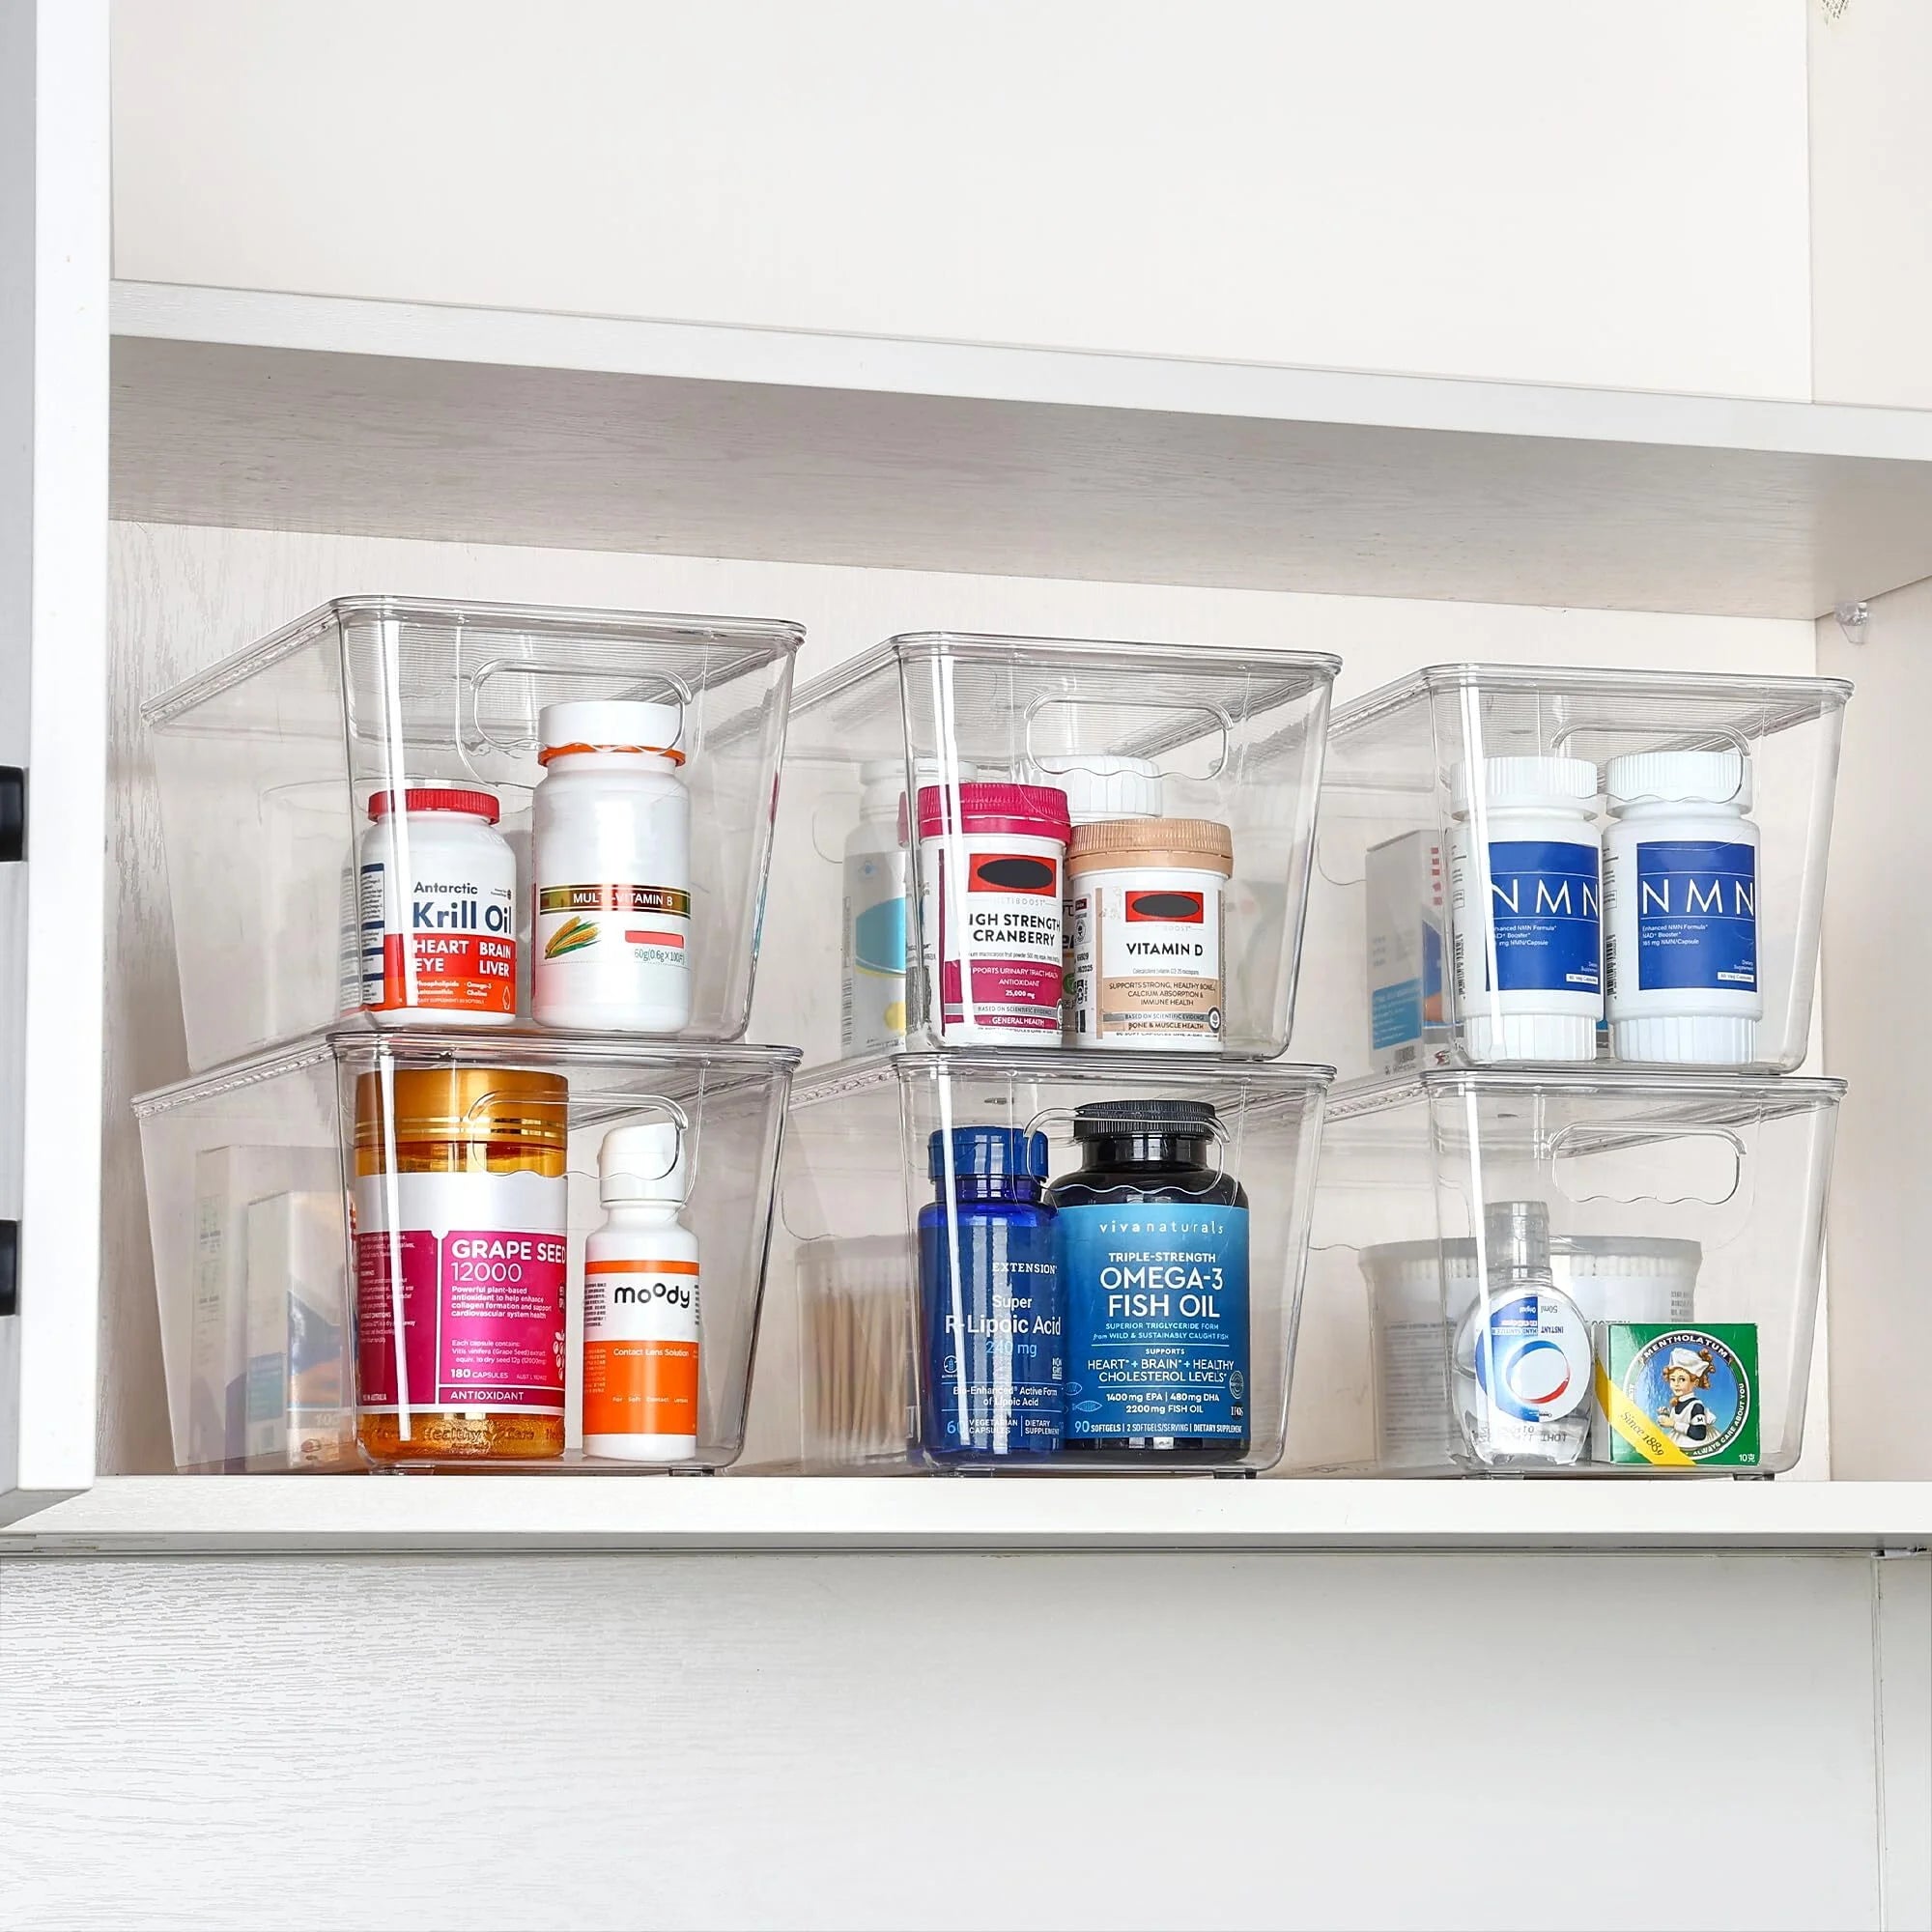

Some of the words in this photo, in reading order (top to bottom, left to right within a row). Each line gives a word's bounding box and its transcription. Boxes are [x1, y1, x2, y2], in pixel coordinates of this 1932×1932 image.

[413, 881, 478, 895] Antarctic
[667, 895, 673, 907] B
[412, 900, 477, 929] Krill
[485, 905, 512, 934] Oil
[969, 913, 998, 926] IGH
[1004, 914, 1061, 932] STRENGTH
[973, 929, 1055, 947] CRANBERRY
[413, 939, 469, 954] HEART
[479, 941, 511, 959] BRAIN
[1126, 943, 1190, 956] VITAMIN
[1194, 943, 1204, 957] D
[414, 958, 444, 972] EYE
[479, 960, 510, 978] LIVER
[1000, 967, 1029, 976] URINARY
[998, 979, 1040, 987] ANTIOXIDANT
[1109, 981, 1143, 990] SUPPORTS
[992, 1016, 1024, 1025] GENERAL
[1024, 1018, 1044, 1027] HEALTH
[1127, 1021, 1148, 1030] BONE
[451, 1239, 532, 1261] GRAPE
[536, 1242, 566, 1264] SEED
[1108, 1252, 1216, 1263] TRIPLE-STRENGTH
[450, 1262, 523, 1283] 12000
[1099, 1266, 1224, 1291] OMEGA-3
[451, 1285, 486, 1293] Powerful
[487, 1286, 527, 1294] plant-based
[614, 1282, 691, 1309] moody
[992, 1294, 1033, 1310] Super
[1108, 1293, 1169, 1318] FISH
[1179, 1294, 1220, 1318] OIL
[451, 1309, 505, 1318] cardiovascular
[1541, 1305, 1558, 1314] 50ml
[1033, 1316, 1062, 1337] Acid
[1541, 1325, 1564, 1334] INSTANT
[469, 1340, 494, 1349] capsule
[986, 1340, 1013, 1354] 240
[1017, 1342, 1037, 1358] mg
[1643, 1334, 1728, 1359] MENTHOLATUM
[613, 1348, 643, 1356] Contact
[664, 1349, 690, 1357] Solution
[1193, 1360, 1235, 1371] HEALTHY
[450, 1368, 471, 1378] 180
[1098, 1372, 1186, 1382] CHOLESTEROL
[450, 1390, 525, 1401] ANTIOXIDANT
[1019, 1386, 1042, 1396] Active
[1043, 1386, 1058, 1396] Form
[983, 1397, 993, 1406] of
[994, 1397, 1021, 1407] Lipoic
[1022, 1398, 1039, 1406] Acid
[1128, 1394, 1144, 1403] mg
[1188, 1394, 1202, 1403] mg
[1203, 1393, 1220, 1402] DHA
[1125, 1405, 1150, 1413] 2200
[1151, 1406, 1166, 1415] mg
[1025, 1427, 1060, 1435] SUPPLEMENT
[1074, 1420, 1090, 1434] 90
[1091, 1424, 1122, 1433] SOFTGELS
[1132, 1423, 1189, 1433] SOFTGELS/SERVING
[1193, 1424, 1216, 1433] DIETARY
[1692, 1440, 1721, 1456] ALWAYS
[1720, 1427, 1737, 1443] CARE
[1735, 1400, 1746, 1427] ABOUT
[1620, 1411, 1645, 1436] Since
[1642, 1433, 1665, 1457] 1889
